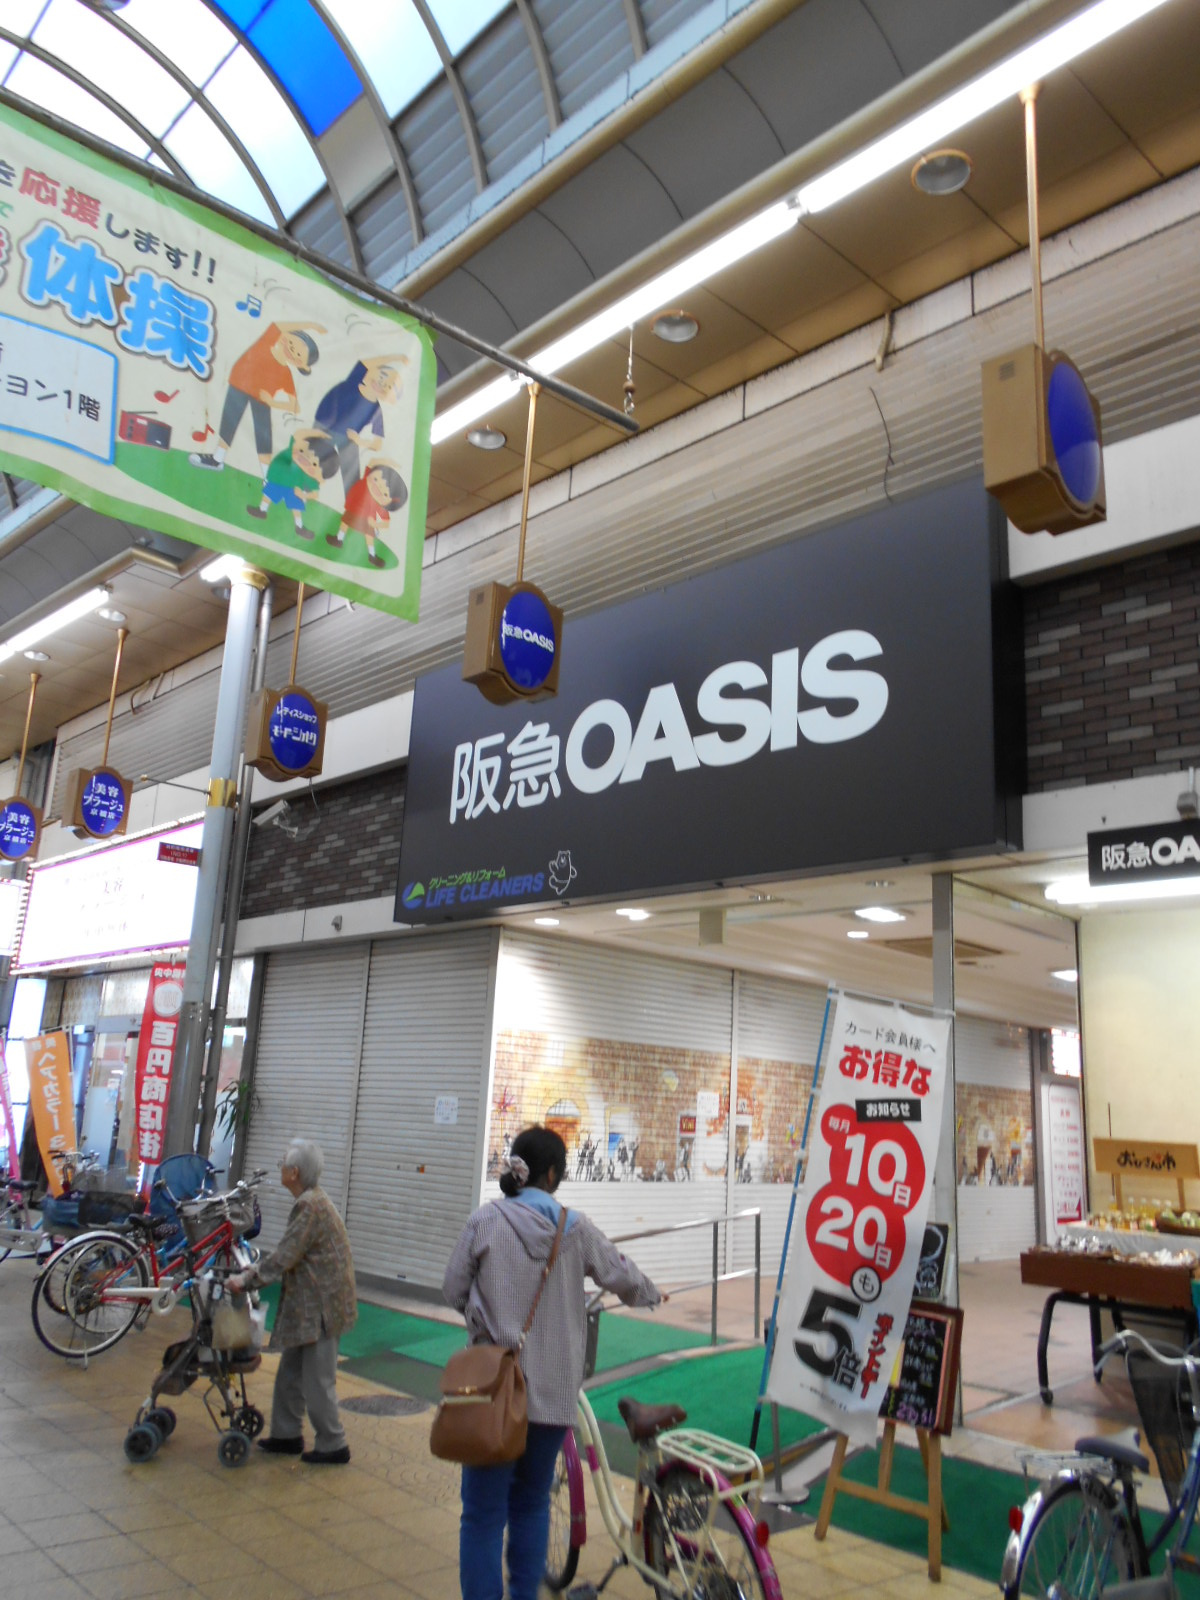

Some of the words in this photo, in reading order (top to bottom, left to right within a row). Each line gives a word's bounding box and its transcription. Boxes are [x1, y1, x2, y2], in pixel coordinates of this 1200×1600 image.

[425, 885, 457, 909] LIFE
[460, 872, 545, 903] CLEANERS
[838, 1044, 932, 1097] お得な
[865, 1102, 911, 1118] お知らせ
[828, 1115, 851, 1134] 毎月
